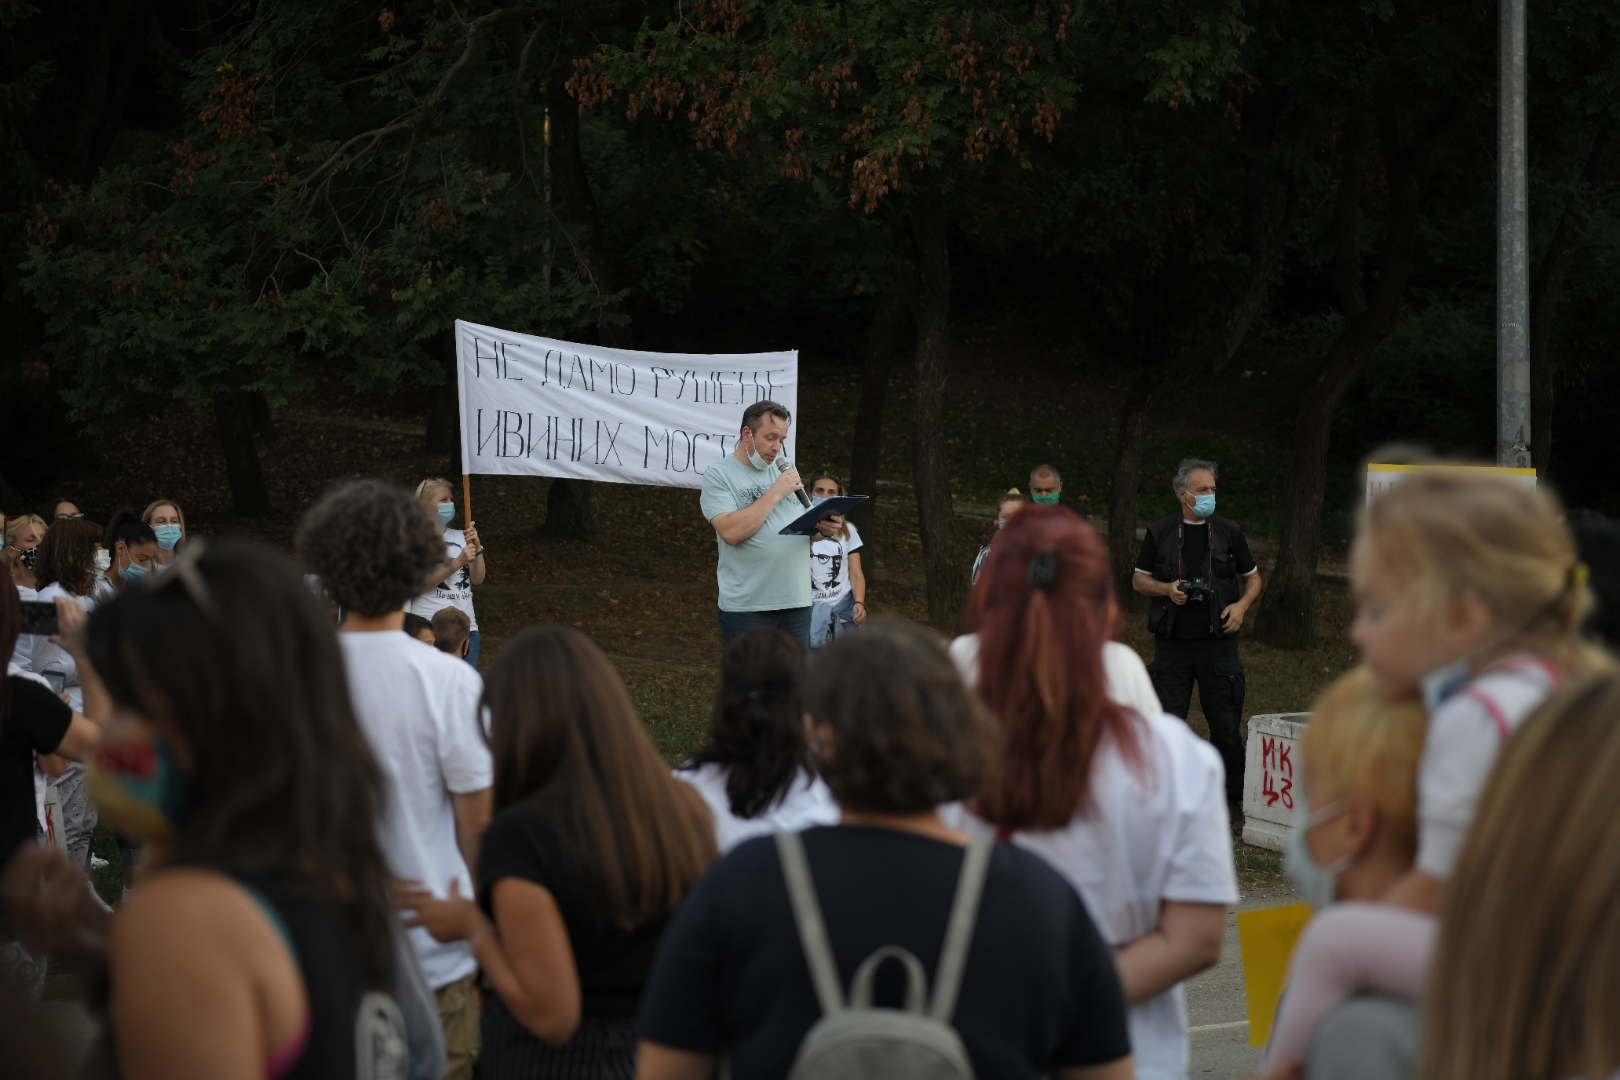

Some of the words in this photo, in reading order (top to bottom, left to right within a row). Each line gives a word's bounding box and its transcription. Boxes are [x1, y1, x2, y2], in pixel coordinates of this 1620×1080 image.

[474, 337, 523, 381] НЕ
[541, 349, 636, 396] ДАМО
[650, 366, 785, 405] РУШЕЊЕ
[475, 408, 623, 467] ИВИНИХ
